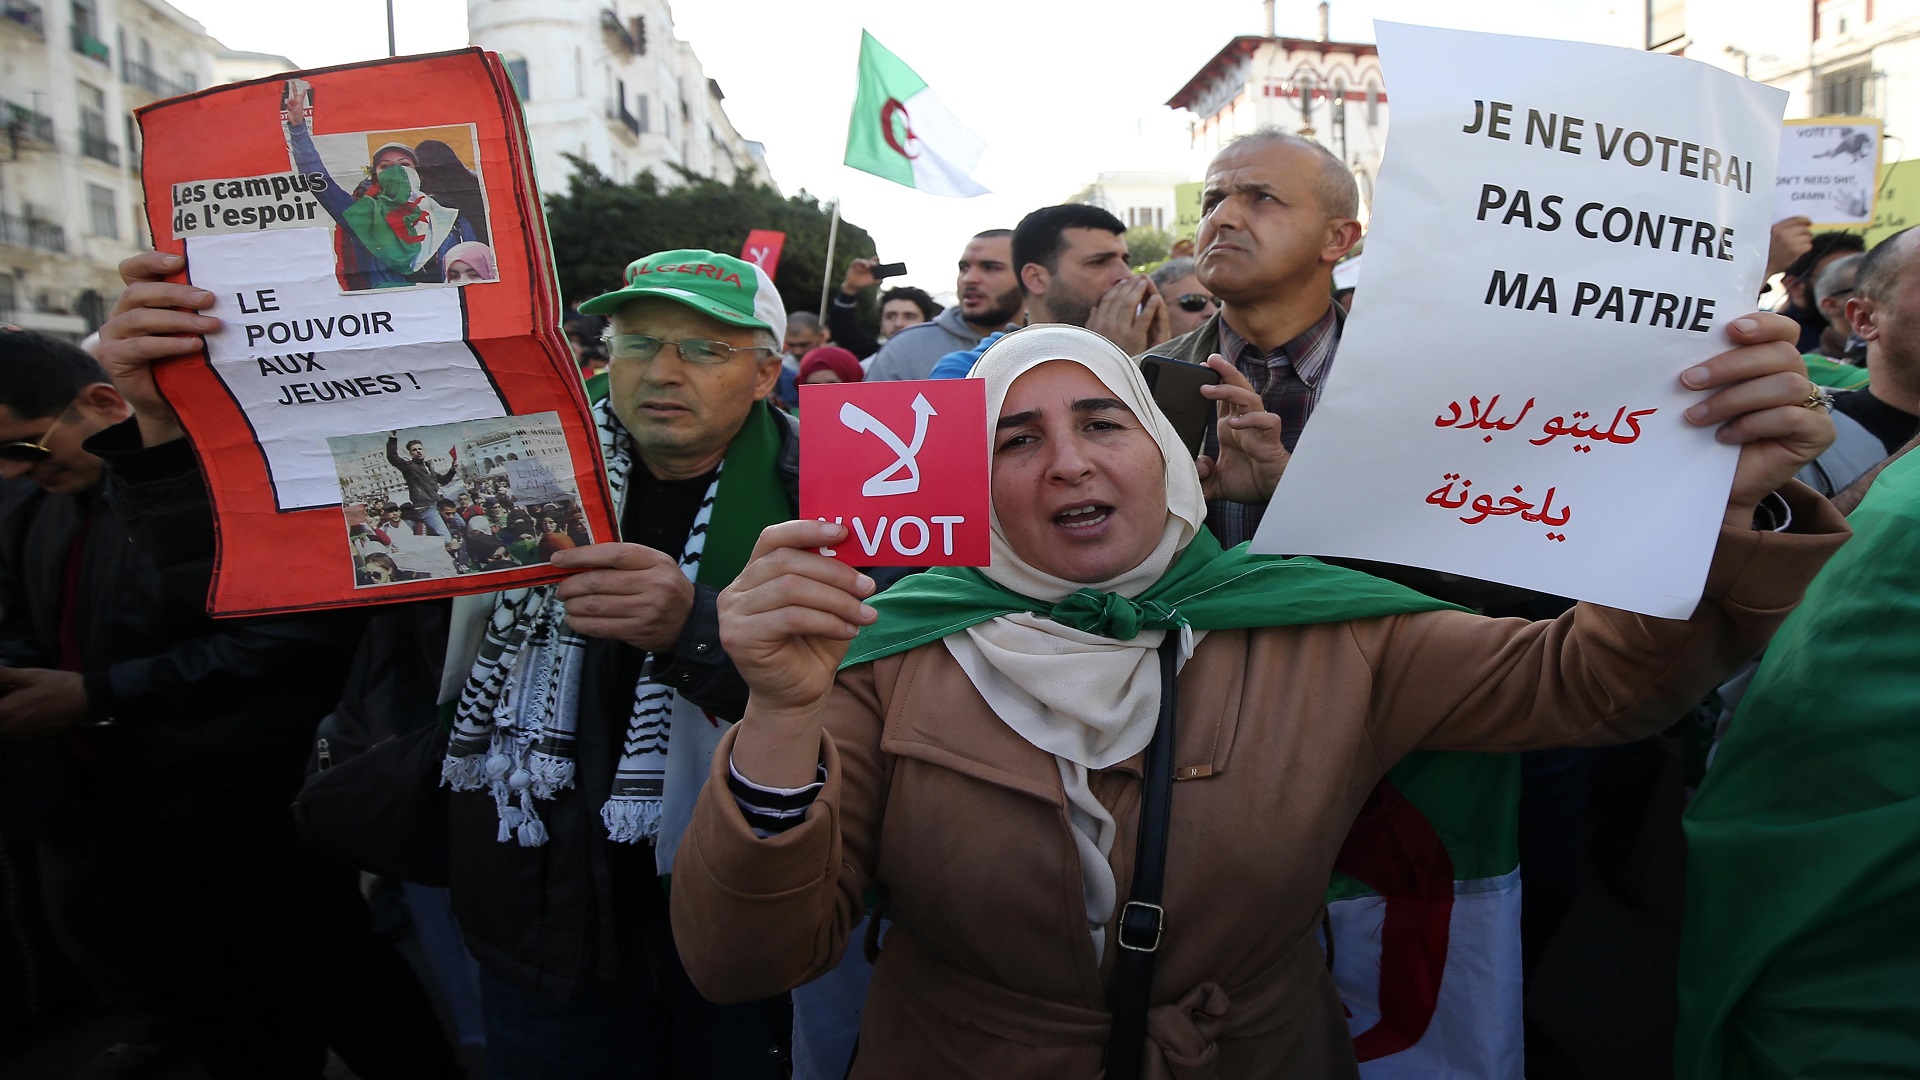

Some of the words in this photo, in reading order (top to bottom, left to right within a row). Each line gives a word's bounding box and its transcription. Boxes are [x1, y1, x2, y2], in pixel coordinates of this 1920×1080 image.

[1462, 99, 1513, 141] JE
[1524, 108, 1584, 155] NE
[1595, 122, 1752, 194] VOTERAI
[1797, 128, 1826, 138] VOTE
[172, 184, 206, 207] Les
[213, 172, 328, 201] campus
[1791, 192, 1825, 201] DAMN
[1804, 175, 1830, 185] NEED
[173, 210, 197, 233] de
[204, 196, 318, 230] l'espoir
[1476, 183, 1564, 232] PAS
[1575, 202, 1734, 262] CONTRE
[629, 263, 742, 288] ALGERIA
[236, 289, 280, 314] LE
[1484, 269, 1558, 314] MA
[1571, 281, 1716, 333] PATRIE
[245, 311, 394, 347] POUVOIR
[257, 352, 326, 376] AUX
[278, 374, 402, 405] JEUNES
[1435, 394, 1536, 443] لبلاد
[1529, 406, 1658, 453] كليتو
